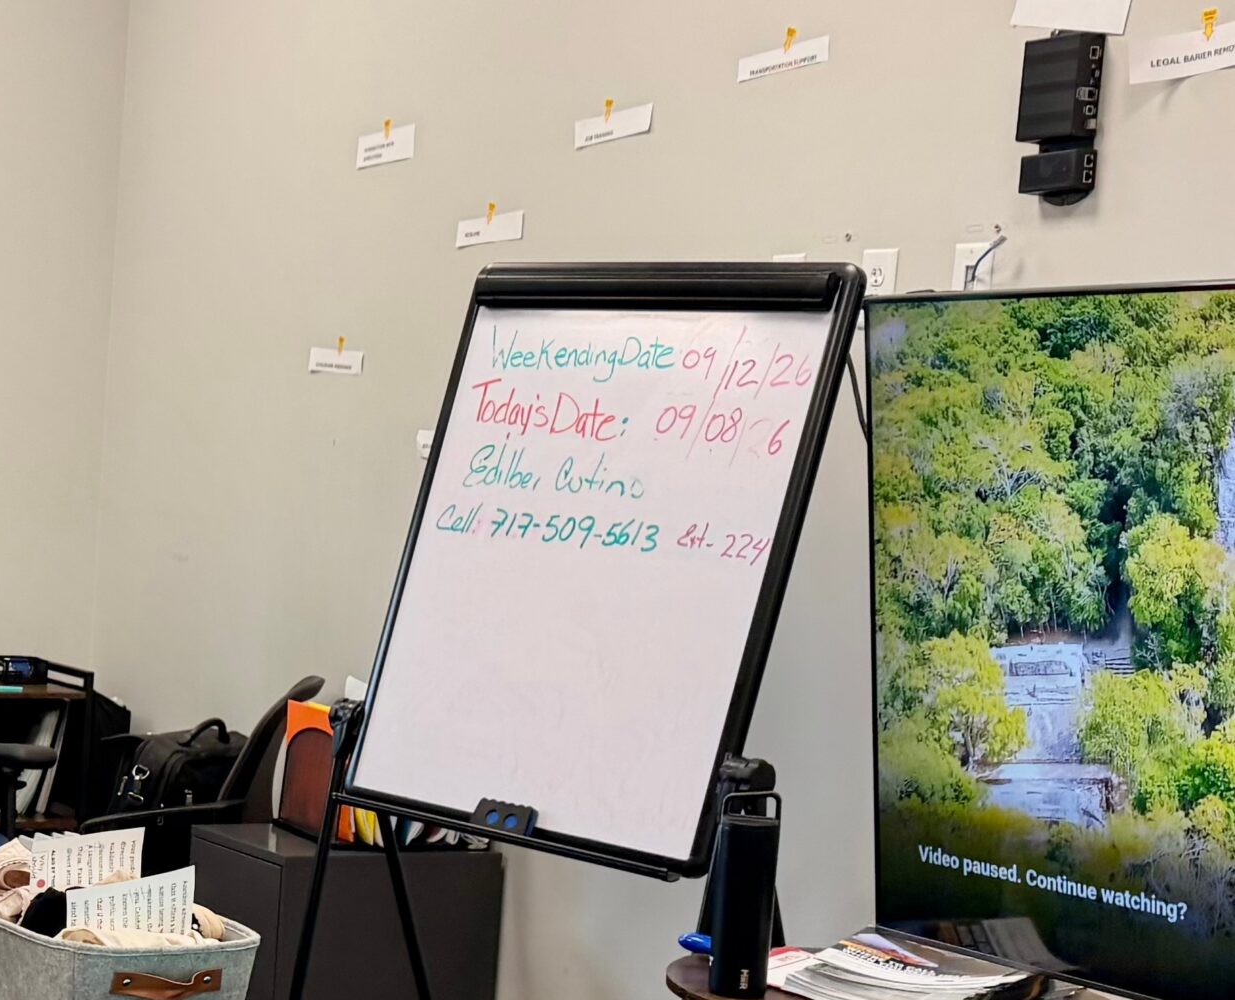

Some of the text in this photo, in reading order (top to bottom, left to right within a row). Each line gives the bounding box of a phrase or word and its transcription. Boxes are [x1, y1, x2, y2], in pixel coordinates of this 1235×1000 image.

[1150, 56, 1181, 68] LEGAL
[490, 508, 659, 552] 717-509-5613
[720, 533, 771, 566] 224
[918, 844, 1188, 924] Video paused. Continue watching?
